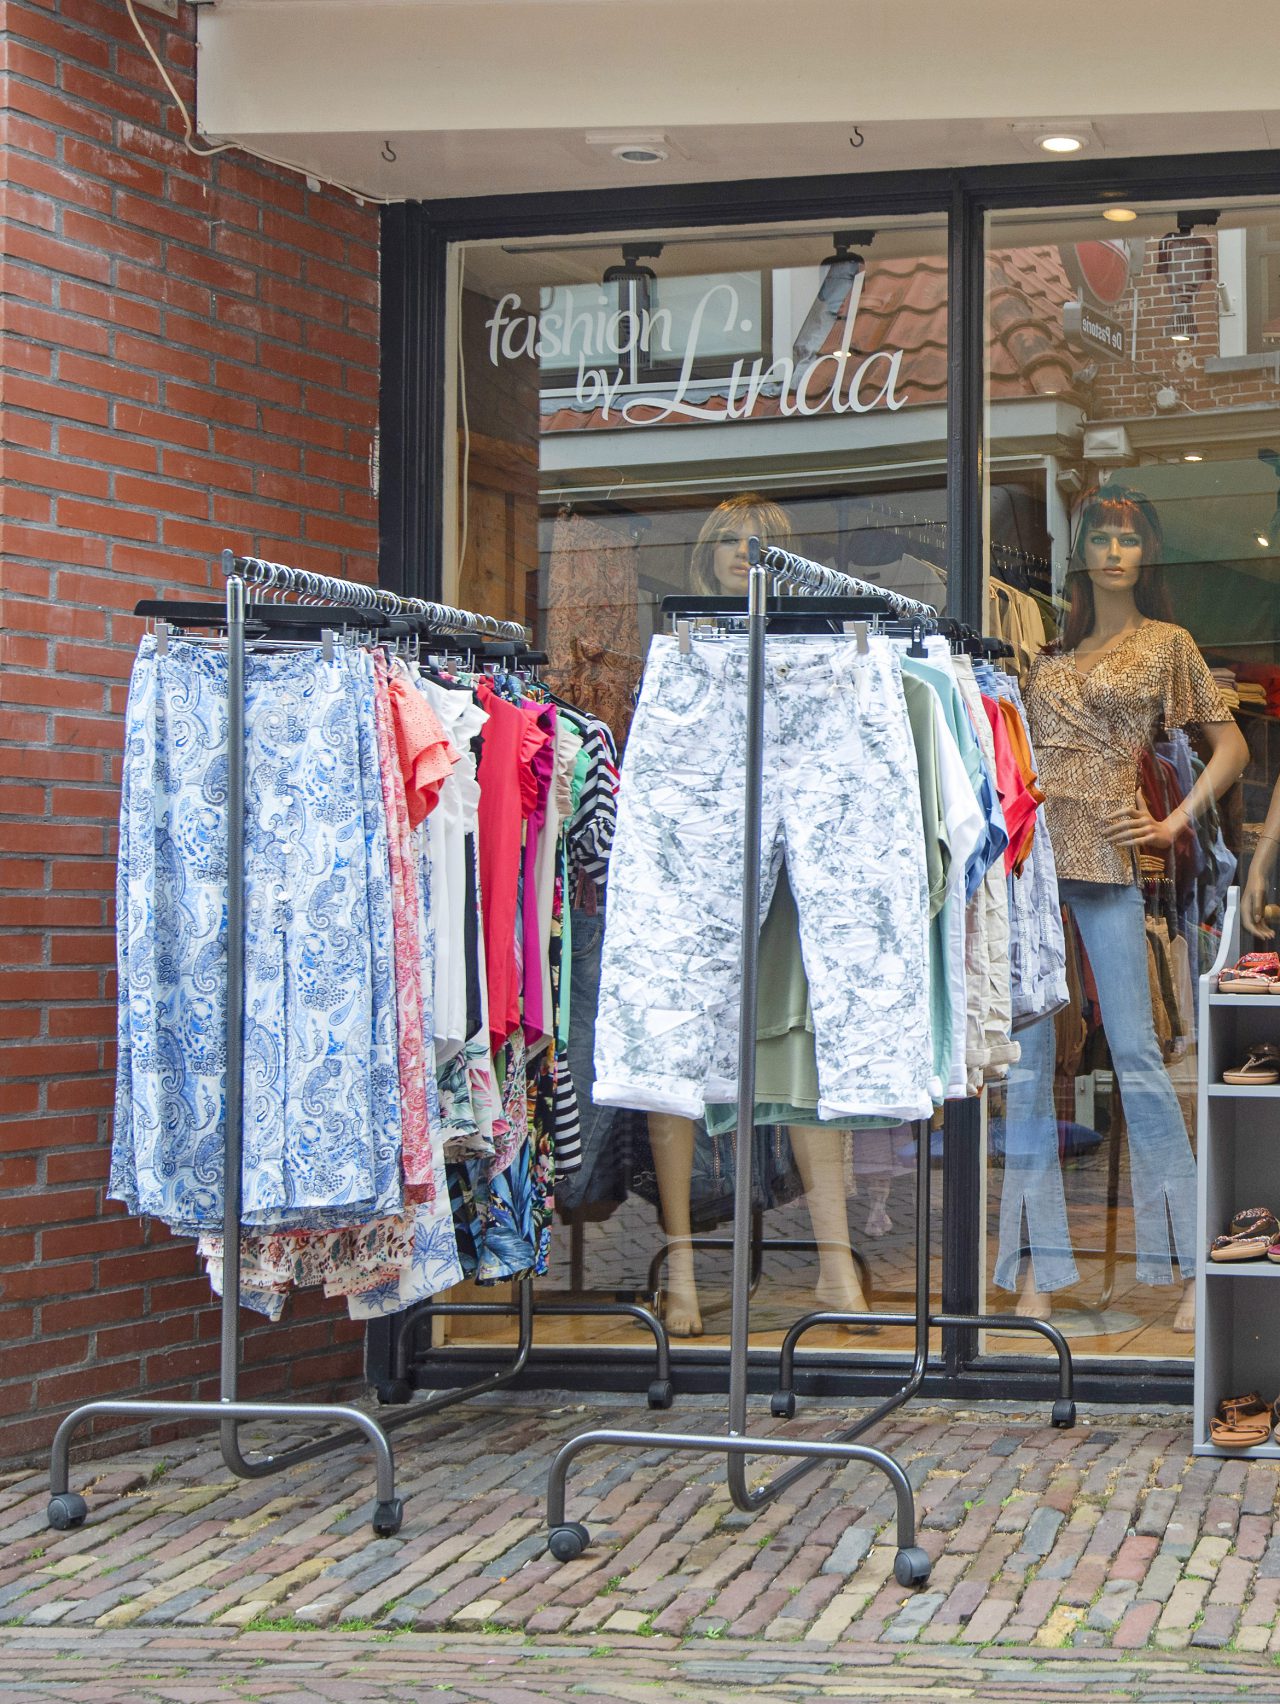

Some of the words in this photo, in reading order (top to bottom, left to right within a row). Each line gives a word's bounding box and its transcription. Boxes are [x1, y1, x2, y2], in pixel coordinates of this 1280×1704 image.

[485, 290, 672, 367] fashion
[576, 351, 623, 421] by
[622, 271, 909, 425] Linda
